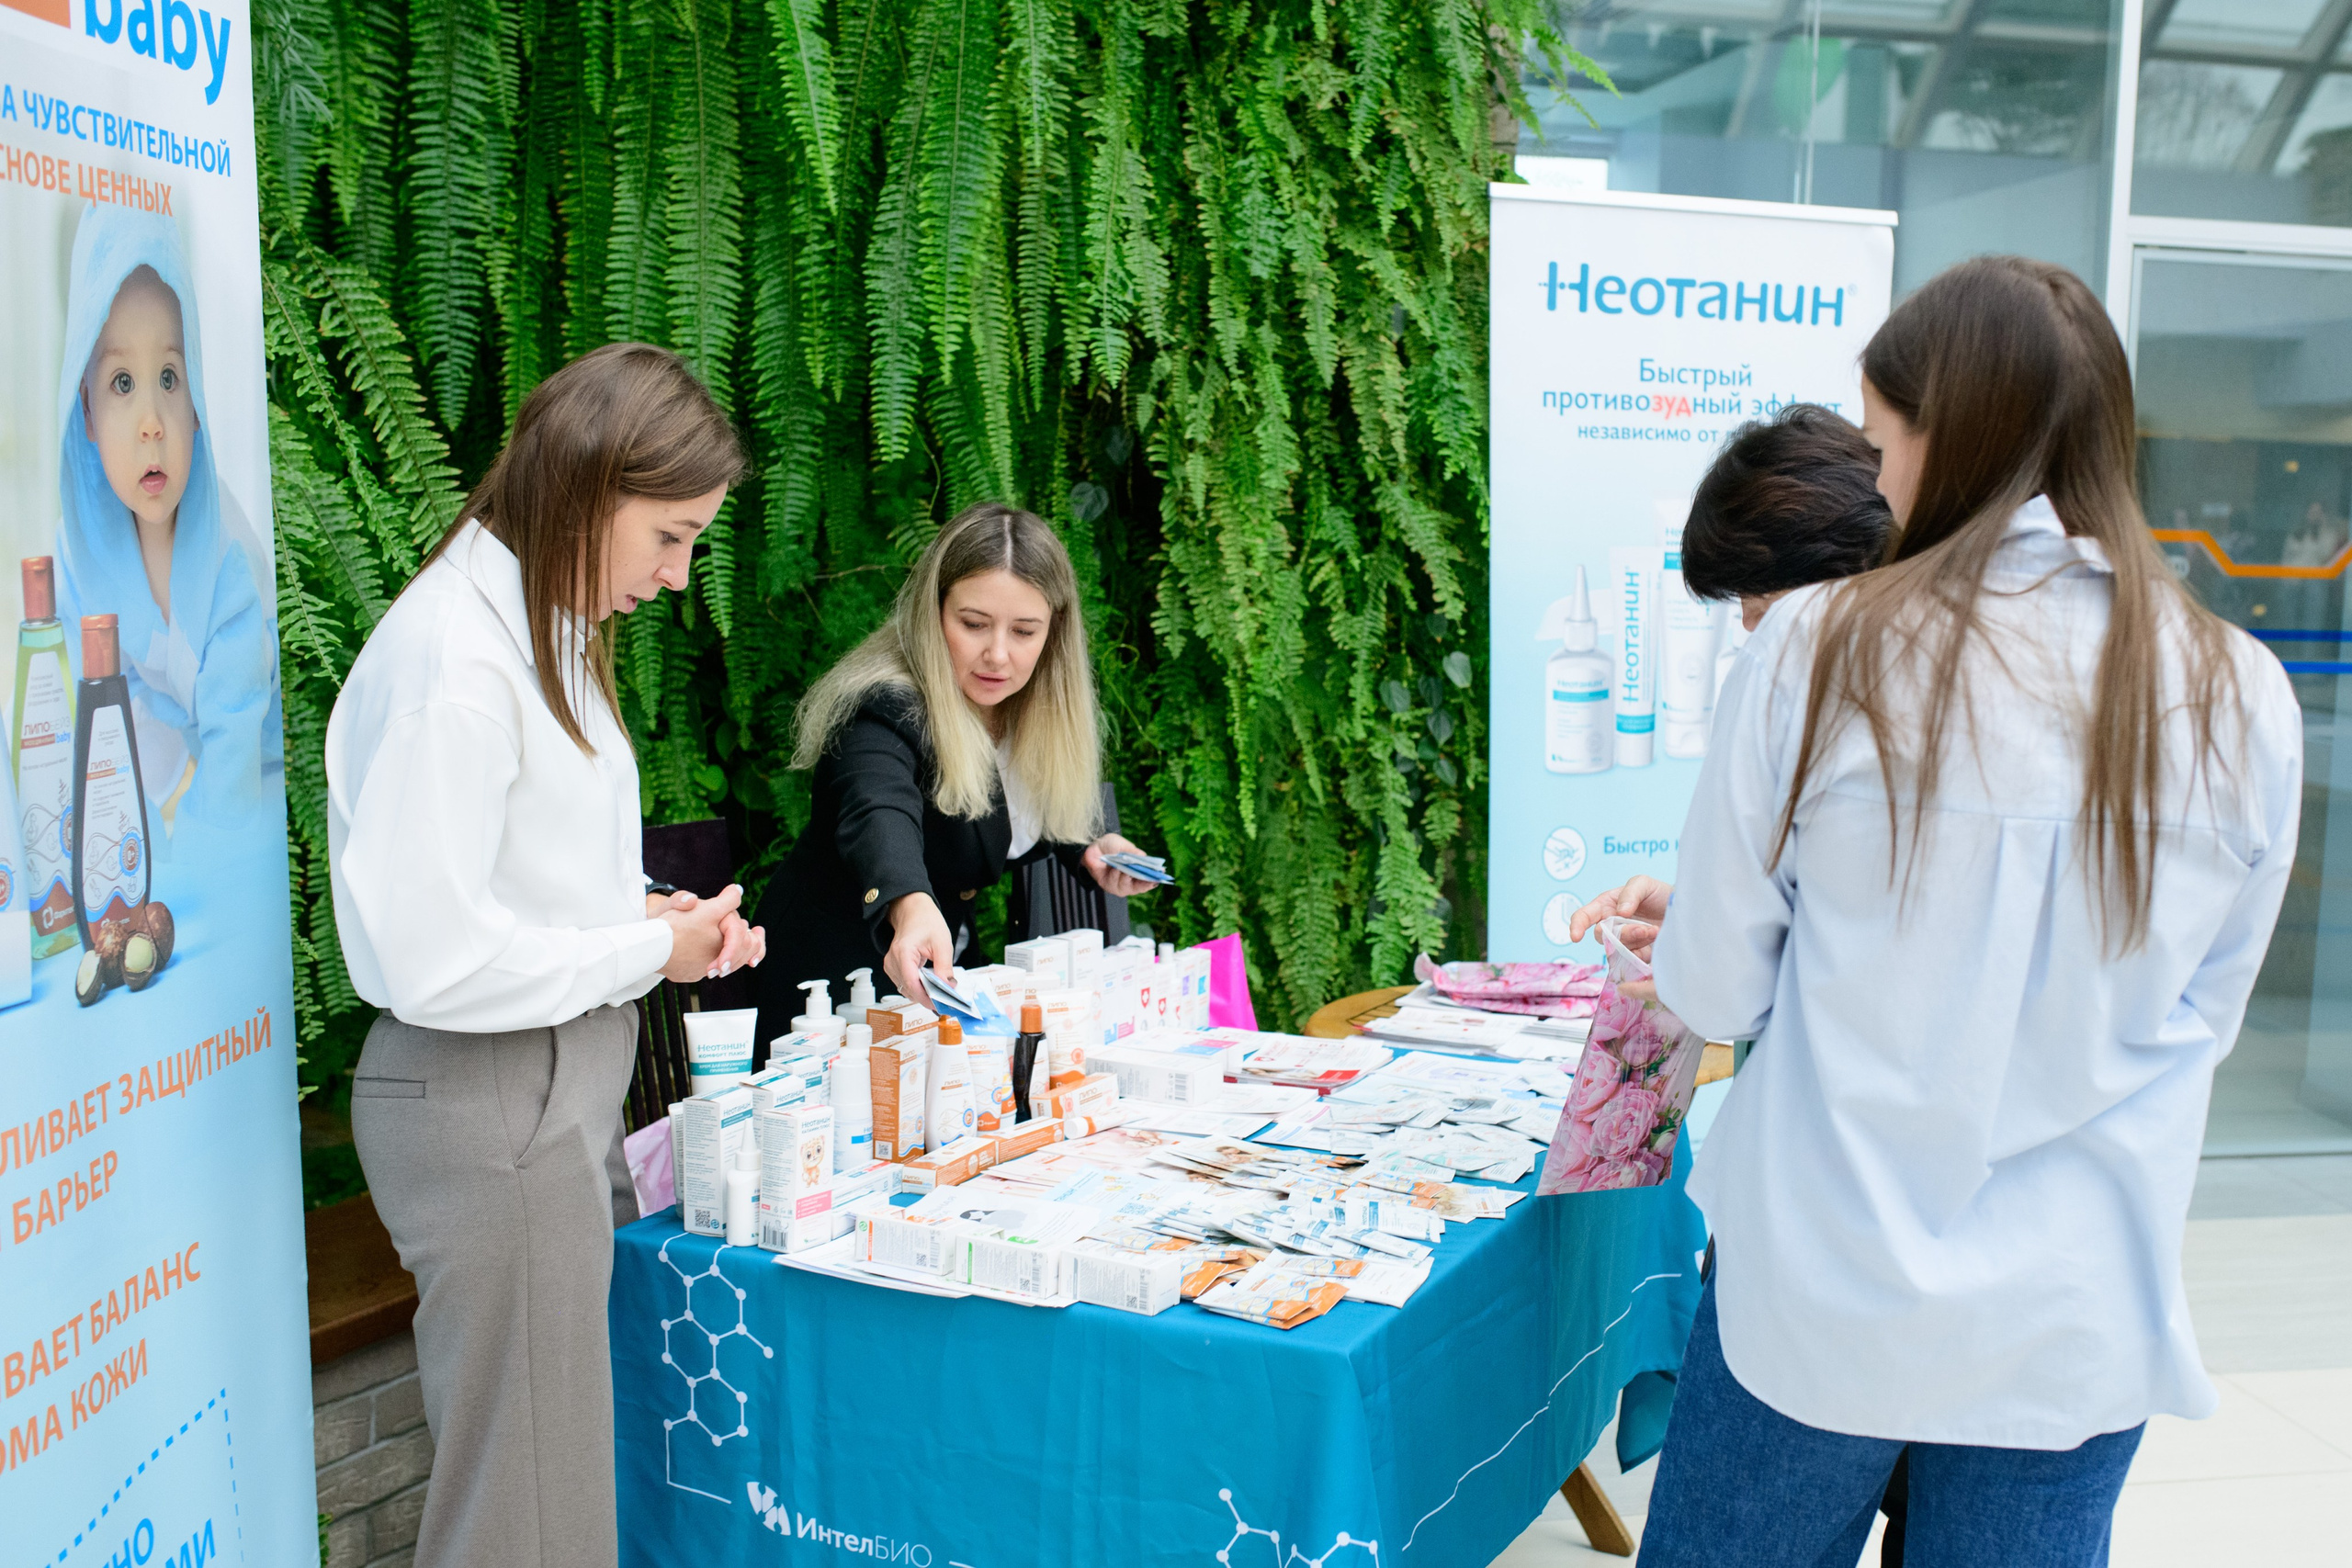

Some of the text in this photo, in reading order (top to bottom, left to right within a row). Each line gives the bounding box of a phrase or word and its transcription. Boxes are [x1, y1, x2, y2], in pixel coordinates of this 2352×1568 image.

[85, 0, 232, 106] baby
[23, 89, 232, 177] ЧУВСТВИТЕЛЬНОЙ
[78, 164, 173, 217] ЦЕННЫХ
[1540, 262, 1844, 326] Неотанин
[1639, 357, 1752, 392] Быстрый
[1543, 391, 1742, 421] противозудный
[1577, 424, 1691, 443] независимо
[1697, 429, 1718, 443] от
[1623, 571, 1640, 703] Неотанин
[1604, 836, 1669, 859] Быстро
[119, 1006, 271, 1115] ЗАЩИТНЫЙ
[697, 1042, 746, 1053] Неотанин
[801, 1116, 831, 1128] Неотанин
[12, 1150, 118, 1245] БАРЬЕР
[90, 1242, 201, 1345] БАЛАНС
[71, 1337, 148, 1431] КОЖИ
[797, 1512, 933, 1568] ИнтелБИО
